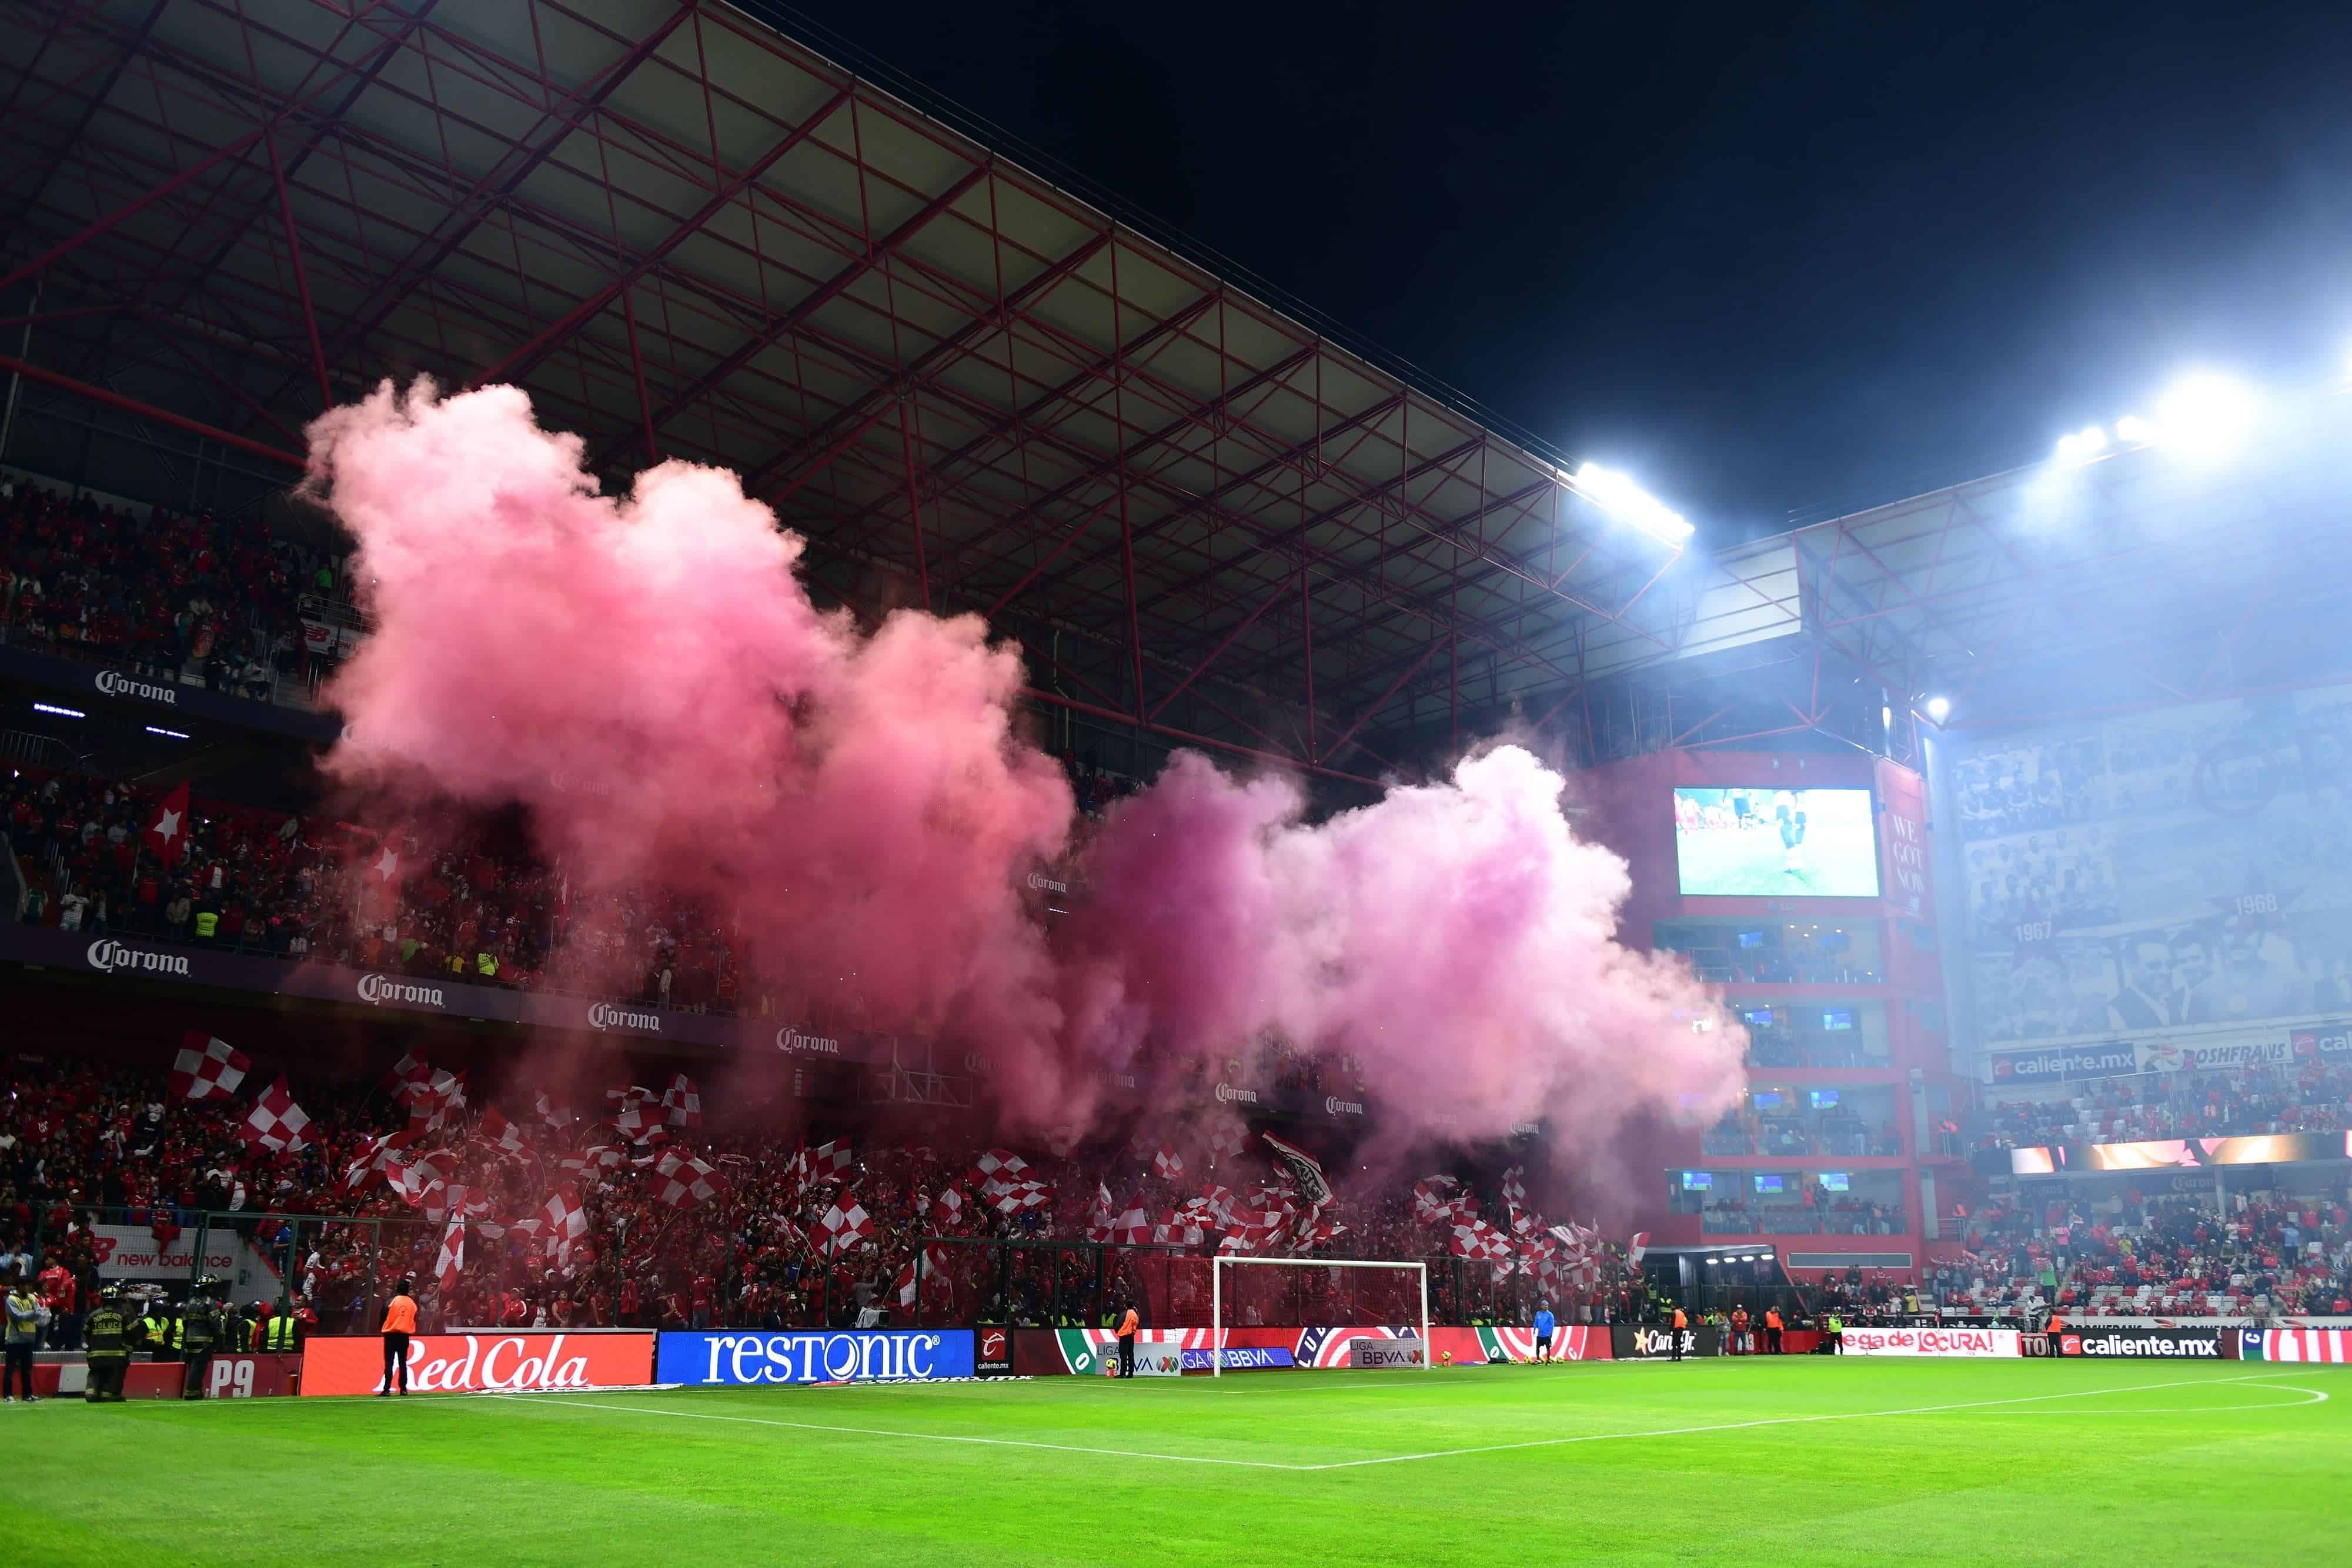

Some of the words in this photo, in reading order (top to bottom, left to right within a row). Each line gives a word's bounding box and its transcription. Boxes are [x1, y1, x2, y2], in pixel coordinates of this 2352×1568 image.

[95, 670, 176, 704] Corona
[1893, 814, 1917, 842] WE
[1893, 842, 1923, 870] GOT
[1027, 872, 1067, 893] Corona
[2235, 894, 2277, 916] 1968
[2014, 921, 2051, 942] 1967
[87, 940, 189, 975] Corona
[358, 974, 443, 1006] Corona
[588, 1003, 660, 1031] Corona
[776, 1028, 838, 1054] Corona
[2016, 1052, 2135, 1075] caliente.mx
[1215, 1083, 1257, 1104] Corona
[1326, 1096, 1363, 1116] Corona
[1510, 1119, 1539, 1136] Corona
[2172, 1176, 2216, 1193] Coron
[118, 1253, 155, 1266] new
[93, 1312, 122, 1323] BOMBEROS
[1351, 1341, 1374, 1350] LIGA
[1888, 1331, 1913, 1346] de
[2082, 1335, 2217, 1355] caliente.mx
[1097, 1345, 1120, 1355] LIGA
[1228, 1348, 1274, 1367] BBVA
[1363, 1351, 1405, 1365] BBVA
[373, 1335, 479, 1392] Red
[482, 1335, 588, 1388] Cola
[211, 1360, 255, 1398] P9
